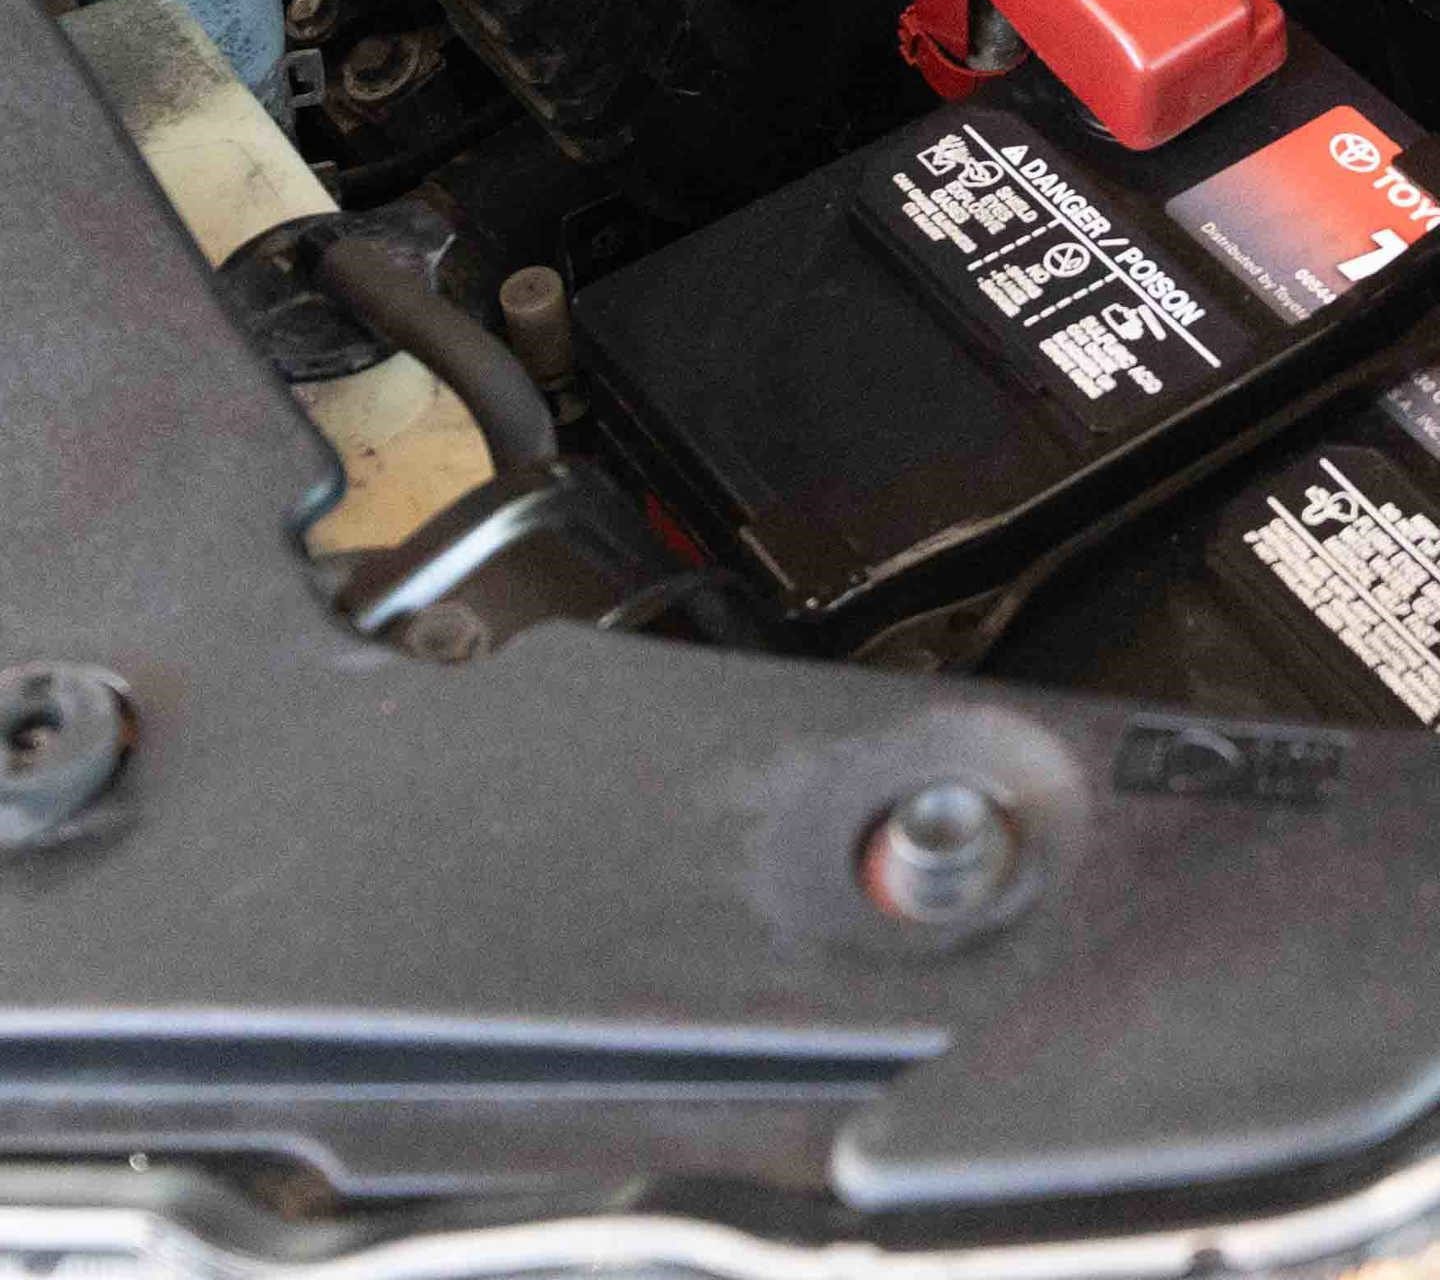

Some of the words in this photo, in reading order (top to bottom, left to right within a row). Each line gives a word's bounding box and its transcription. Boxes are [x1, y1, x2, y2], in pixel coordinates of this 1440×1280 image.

[1019, 158, 1112, 239] DANGER
[1114, 246, 1207, 328] POISON
[1199, 221, 1263, 276] Distributed
